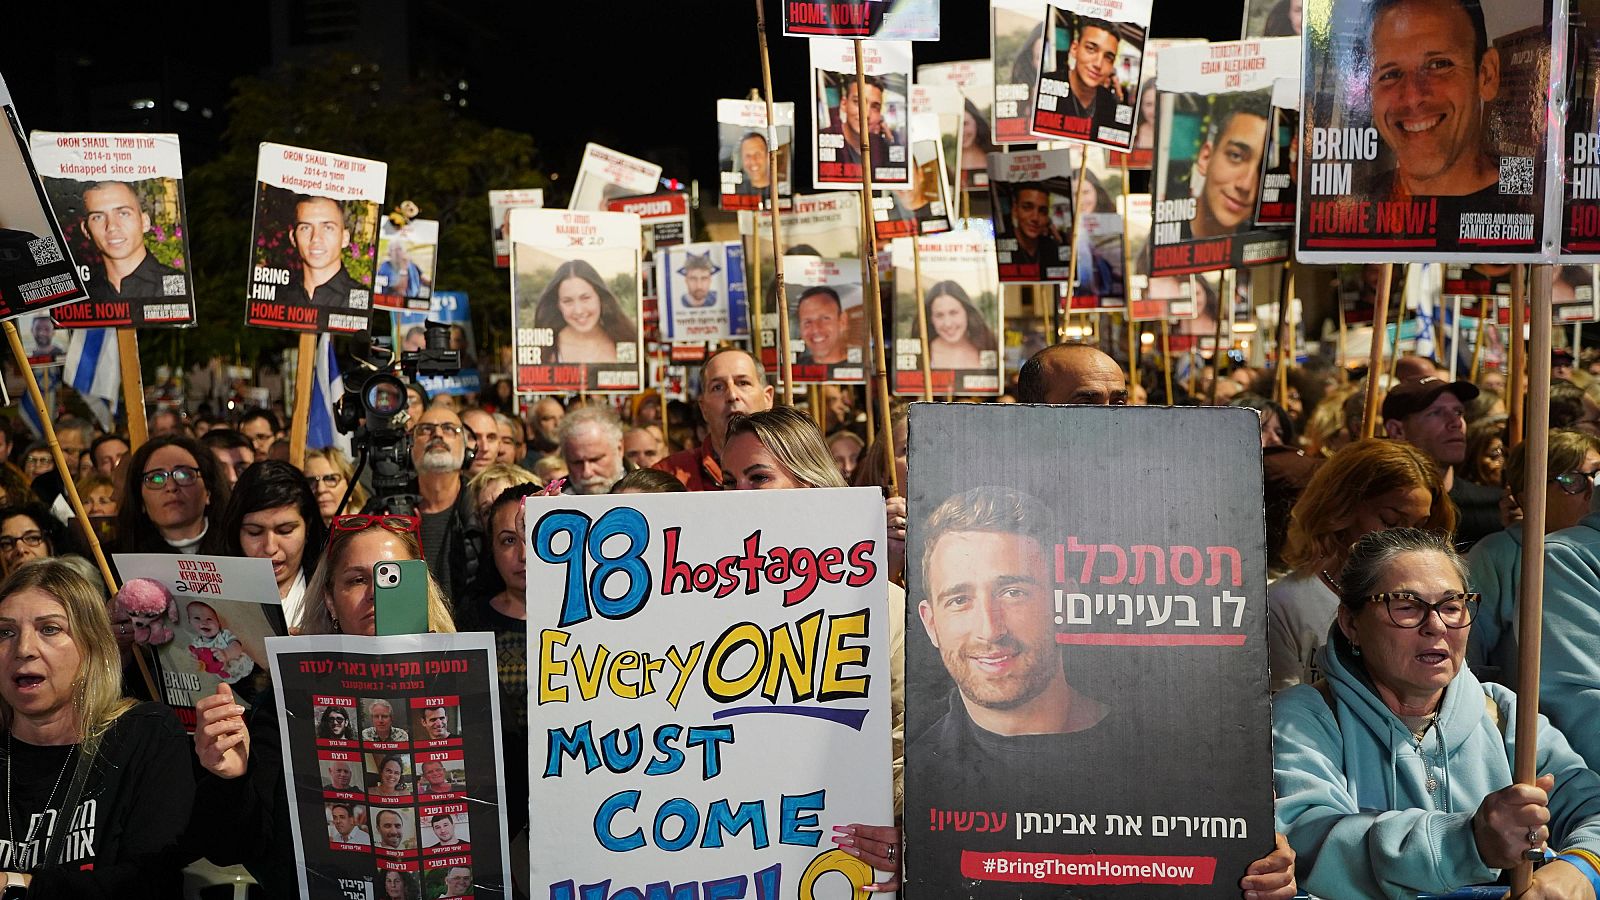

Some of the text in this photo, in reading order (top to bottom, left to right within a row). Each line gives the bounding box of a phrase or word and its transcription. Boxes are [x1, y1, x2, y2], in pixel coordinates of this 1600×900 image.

[790, 3, 827, 25] HOME
[830, 1, 870, 26] NOW!
[57, 138, 109, 148] ORON SHAUL
[115, 137, 156, 149] אורון שאול
[1313, 127, 1378, 160] BRING
[283, 150, 328, 167] ORON SHAUL
[60, 163, 157, 177] kidnapped since 2014
[1311, 163, 1352, 196] HIM
[281, 174, 364, 195] kidnapped since 2014
[1155, 198, 1197, 223] BRING
[1309, 197, 1438, 235] HOME NOW!
[1460, 213, 1534, 226] HOSTAGES AND MISSING
[1154, 222, 1181, 246] HIM
[1459, 225, 1534, 241] FAMILIES FORUM
[1154, 237, 1232, 268] HOME NOW!
[253, 267, 290, 285] BRING
[22, 286, 53, 303] FAMILIES
[52, 279, 76, 296] FORUM
[252, 284, 276, 301] HIM
[54, 302, 131, 321] HOME NOW!
[250, 303, 286, 321] HOME
[287, 307, 318, 324] NOW!
[517, 328, 554, 347] BRING
[517, 346, 543, 365] HER
[177, 560, 216, 575] כפיר ביבס
[532, 506, 877, 628] 98 hostages
[1054, 536, 1243, 586] תסתכלו
[178, 571, 223, 587] KFIR BIBAS
[1054, 588, 1246, 628] לו בעיניים!
[299, 658, 469, 679] נחטפו מקיבוץ בארי לעזה
[164, 671, 201, 691] BRING
[400, 680, 425, 690] בשבת
[166, 689, 191, 707] HIM
[317, 697, 352, 707] נרצח בשבי
[425, 697, 444, 706] נרצח
[331, 752, 348, 761] נרצח
[430, 752, 448, 762] נרצח
[542, 720, 735, 781] MUST
[424, 804, 463, 816] נרצח בשבי
[593, 789, 826, 853] COME
[930, 807, 1248, 841] מחזירים את אבינתן עכשיו!
[386, 862, 407, 871] נרצחה
[428, 857, 467, 869] נרצח בשבי
[983, 857, 1195, 879] #BringThemHomeNow
[337, 878, 365, 892] קיבוץ
